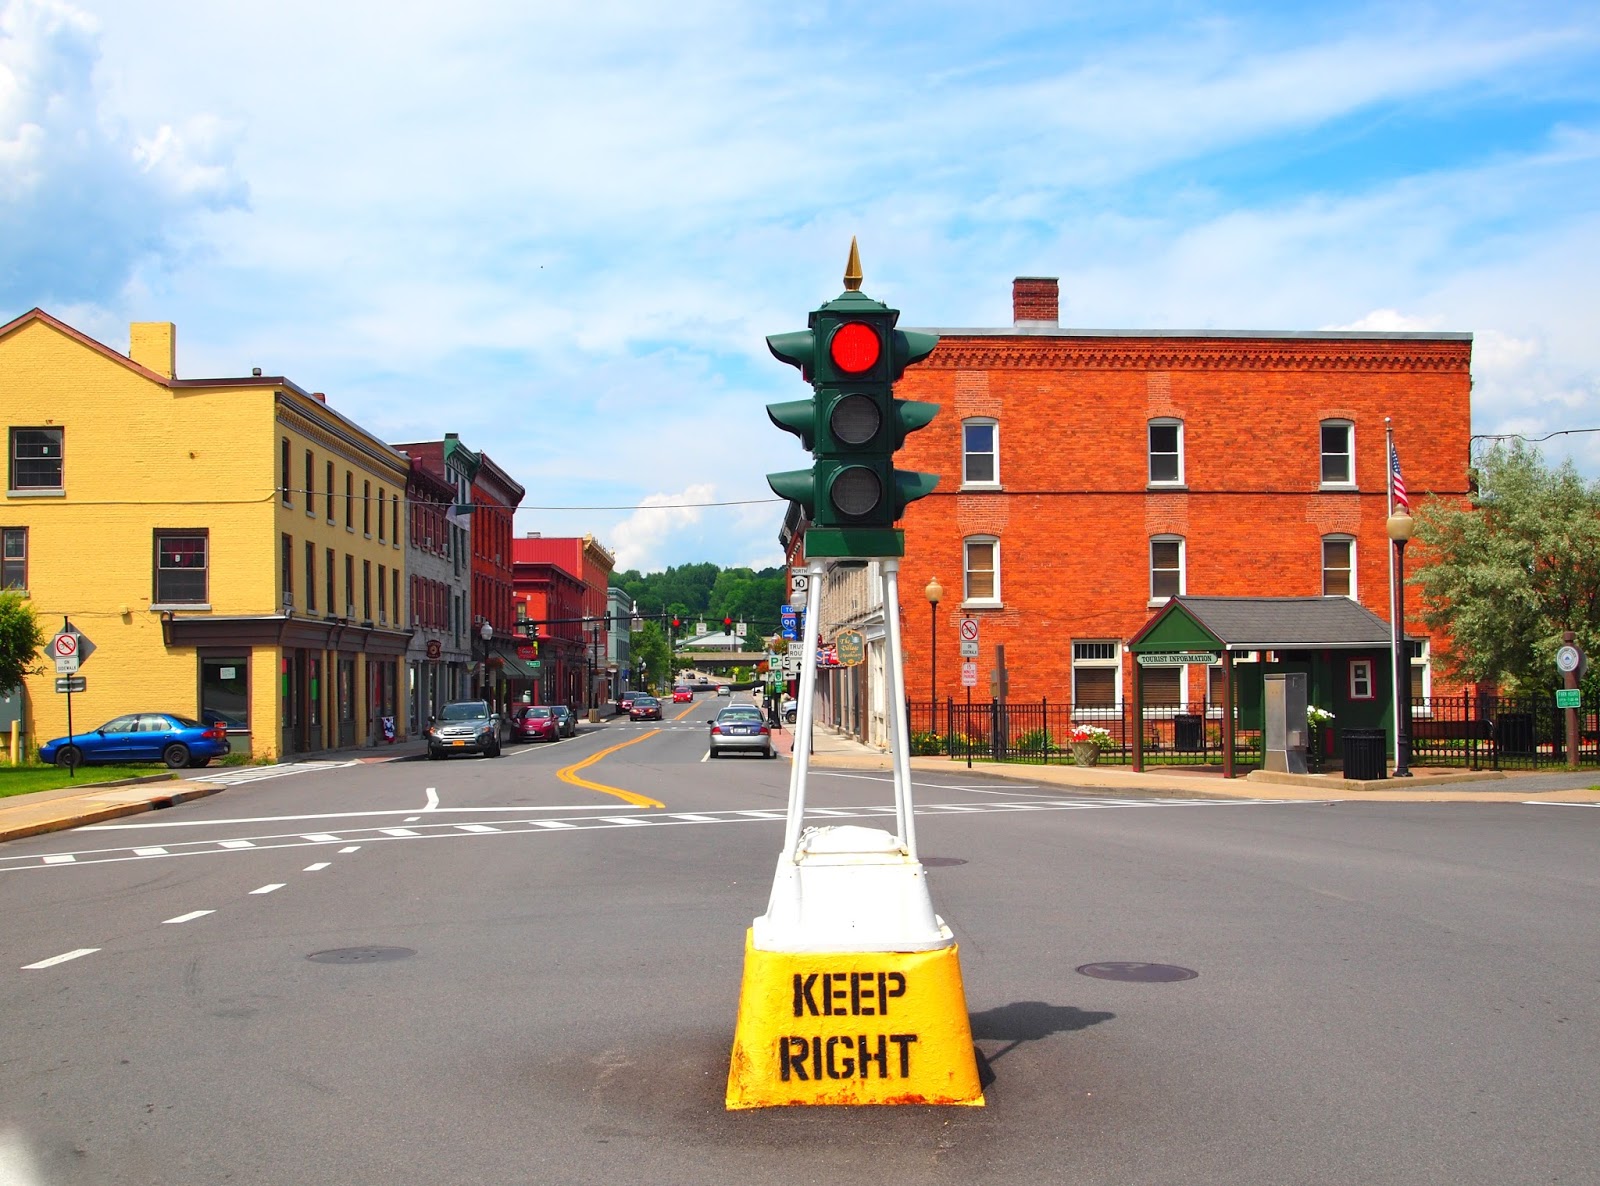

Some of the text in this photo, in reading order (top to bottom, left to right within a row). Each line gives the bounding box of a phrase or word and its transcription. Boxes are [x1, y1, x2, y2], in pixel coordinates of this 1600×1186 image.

[795, 579, 805, 588] 10
[784, 619, 795, 627] 90
[771, 658, 778, 667] P
[793, 971, 907, 1018] KEEP
[779, 1033, 918, 1082] RIGHT
